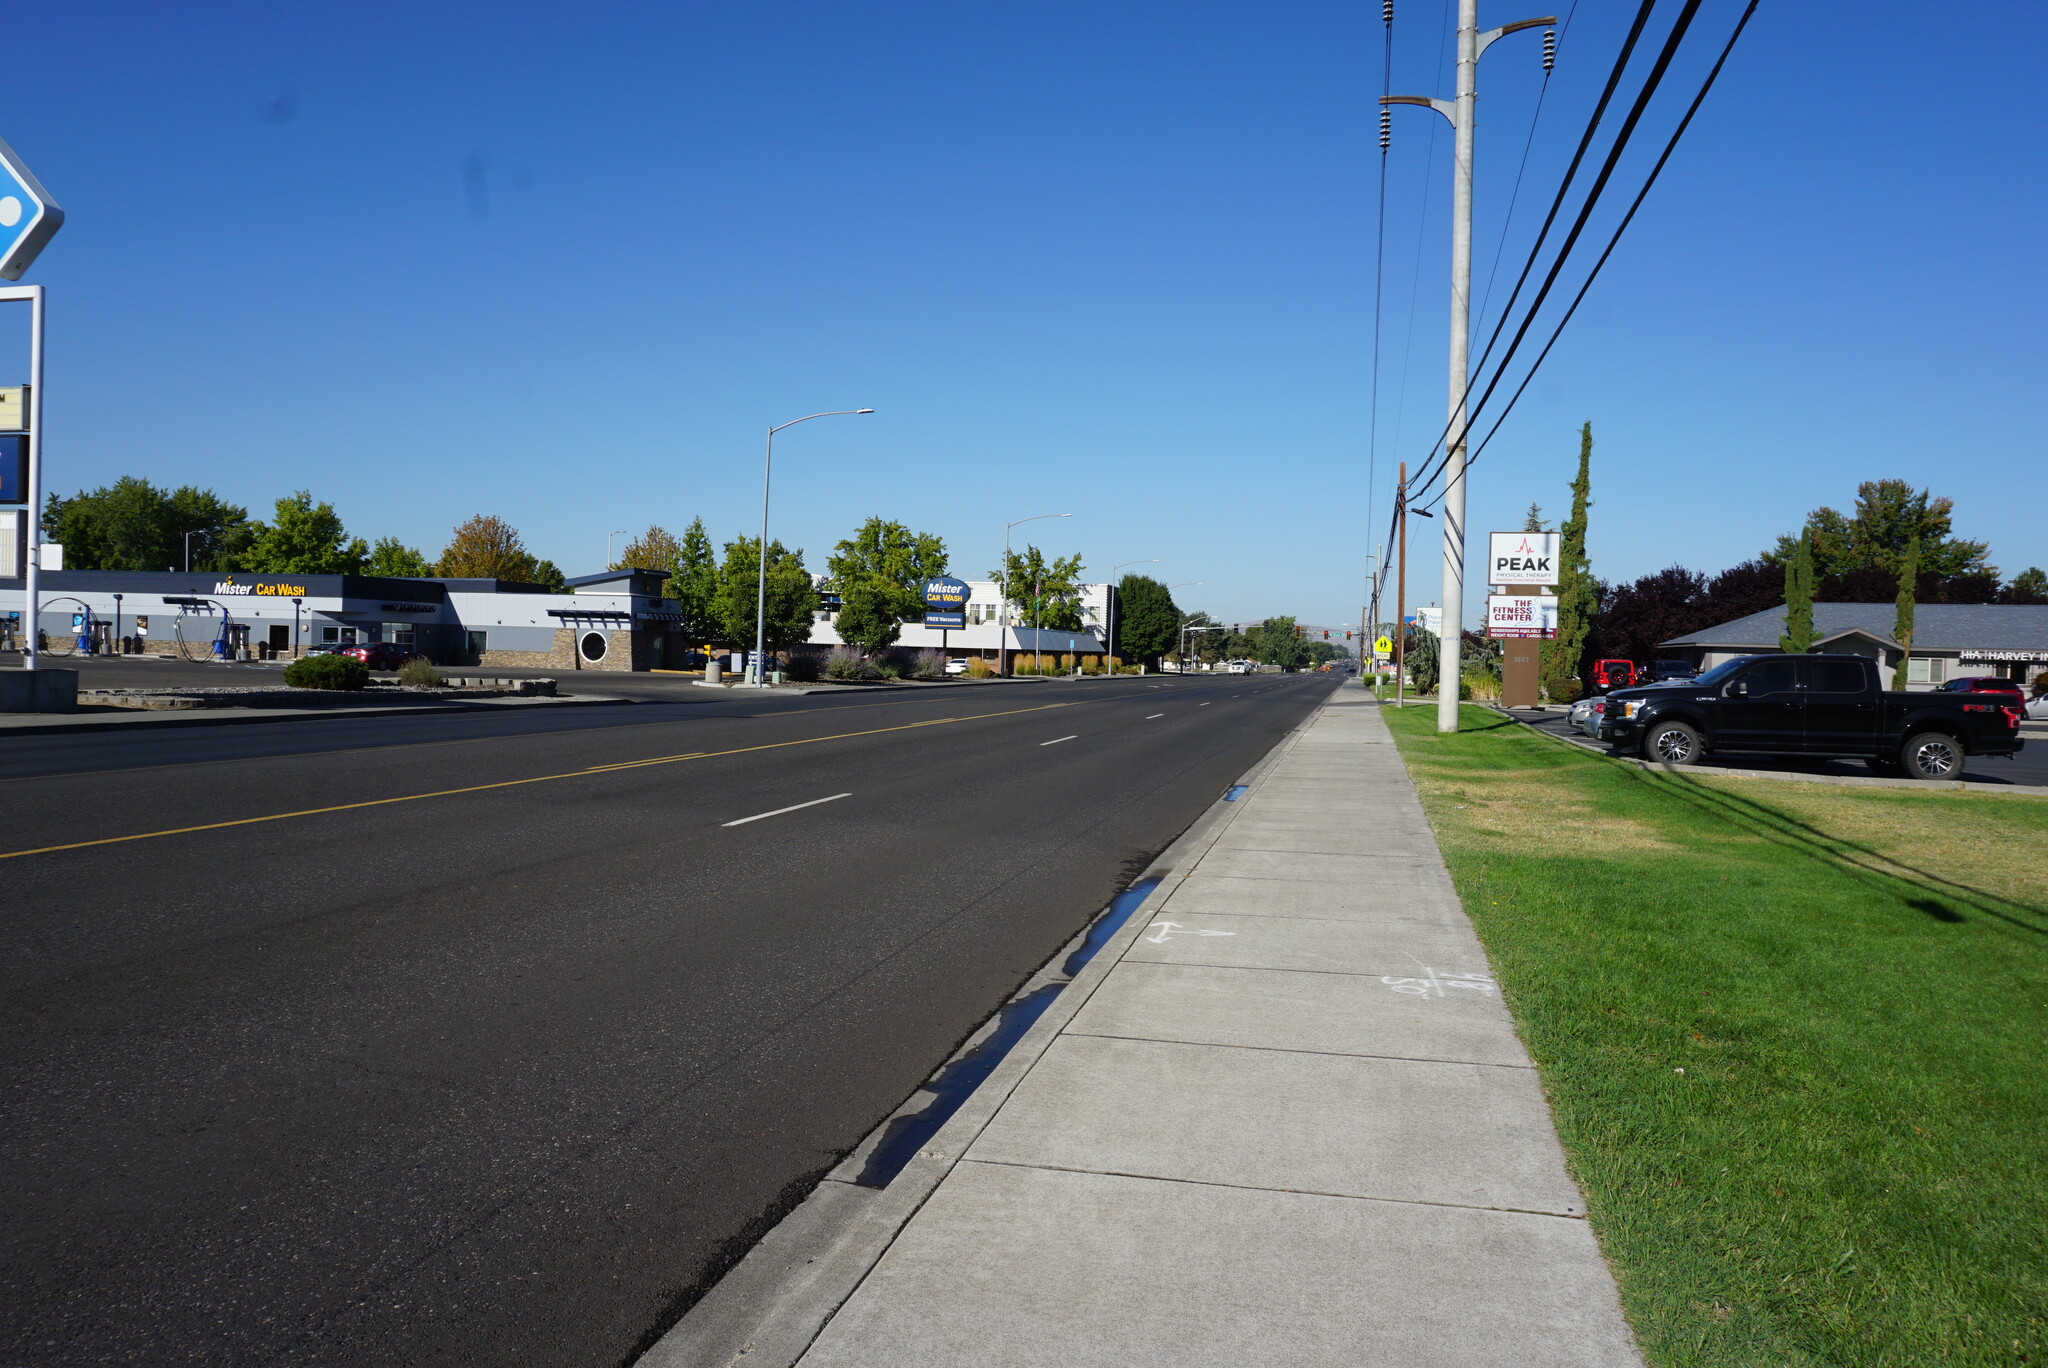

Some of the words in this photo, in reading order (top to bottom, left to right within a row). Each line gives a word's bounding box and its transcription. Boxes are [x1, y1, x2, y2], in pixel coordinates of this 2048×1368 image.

[1497, 557, 1551, 571] PEAK
[214, 580, 253, 595] Mister
[256, 583, 276, 596] CAR
[277, 583, 305, 597] WASH
[927, 582, 963, 594] Mister
[927, 593, 941, 602] CAR
[943, 594, 963, 602] WASH
[1493, 606, 1533, 614] FITNESS
[1494, 613, 1532, 621] CENTER
[1988, 651, 2036, 661] HARVEY
